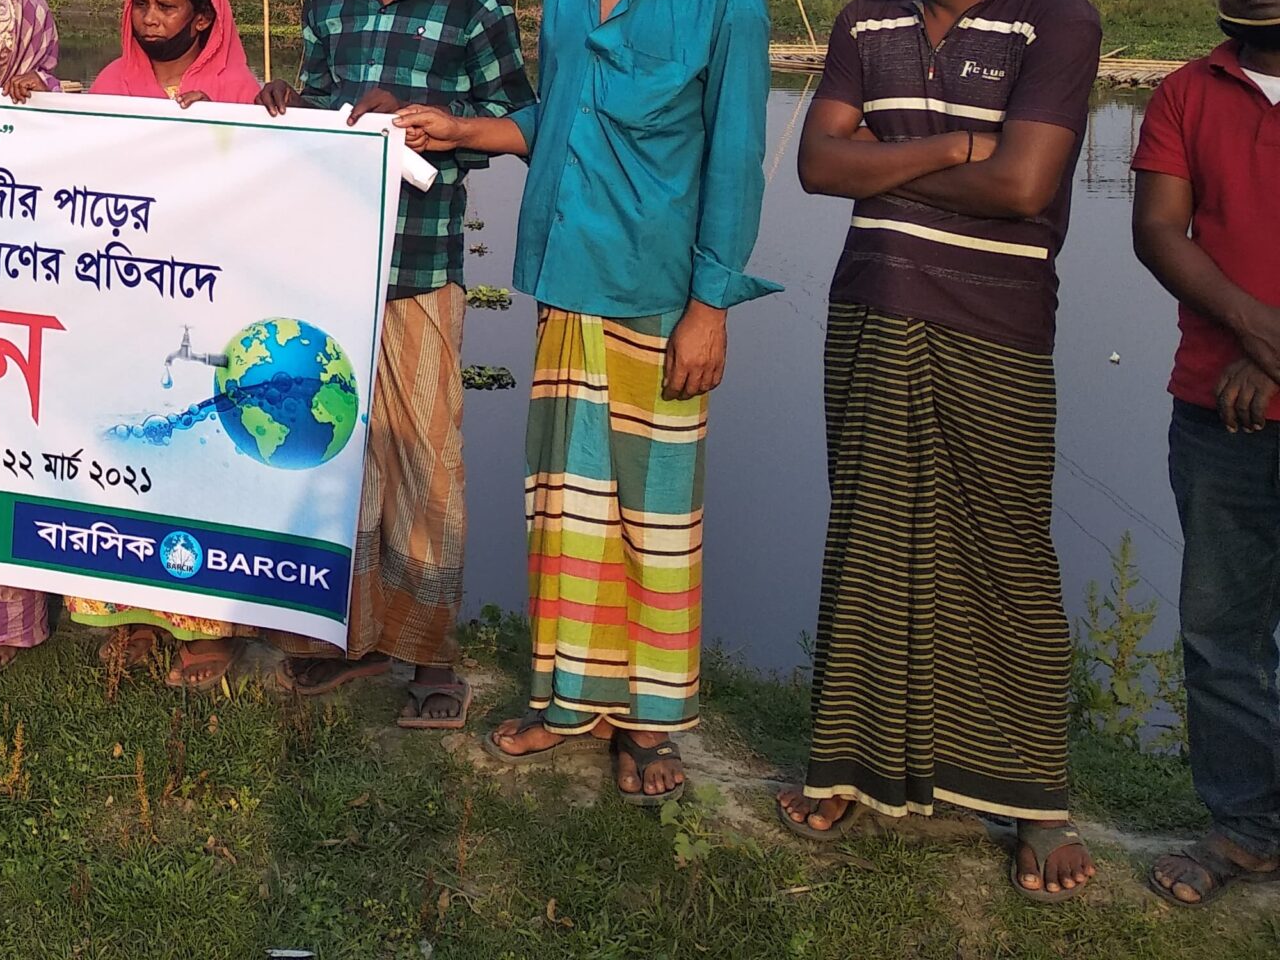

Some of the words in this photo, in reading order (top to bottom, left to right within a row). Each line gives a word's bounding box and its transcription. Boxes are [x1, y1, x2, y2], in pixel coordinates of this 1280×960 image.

[54, 185, 156, 237] পাড়ের
[75, 240, 222, 303] প্রতিবাদে
[3, 449, 34, 479] ২২
[42, 449, 84, 481] মার্চ
[89, 461, 152, 493] ২০২১
[34, 521, 156, 562] বারসিক
[207, 549, 331, 590] BARCIK
